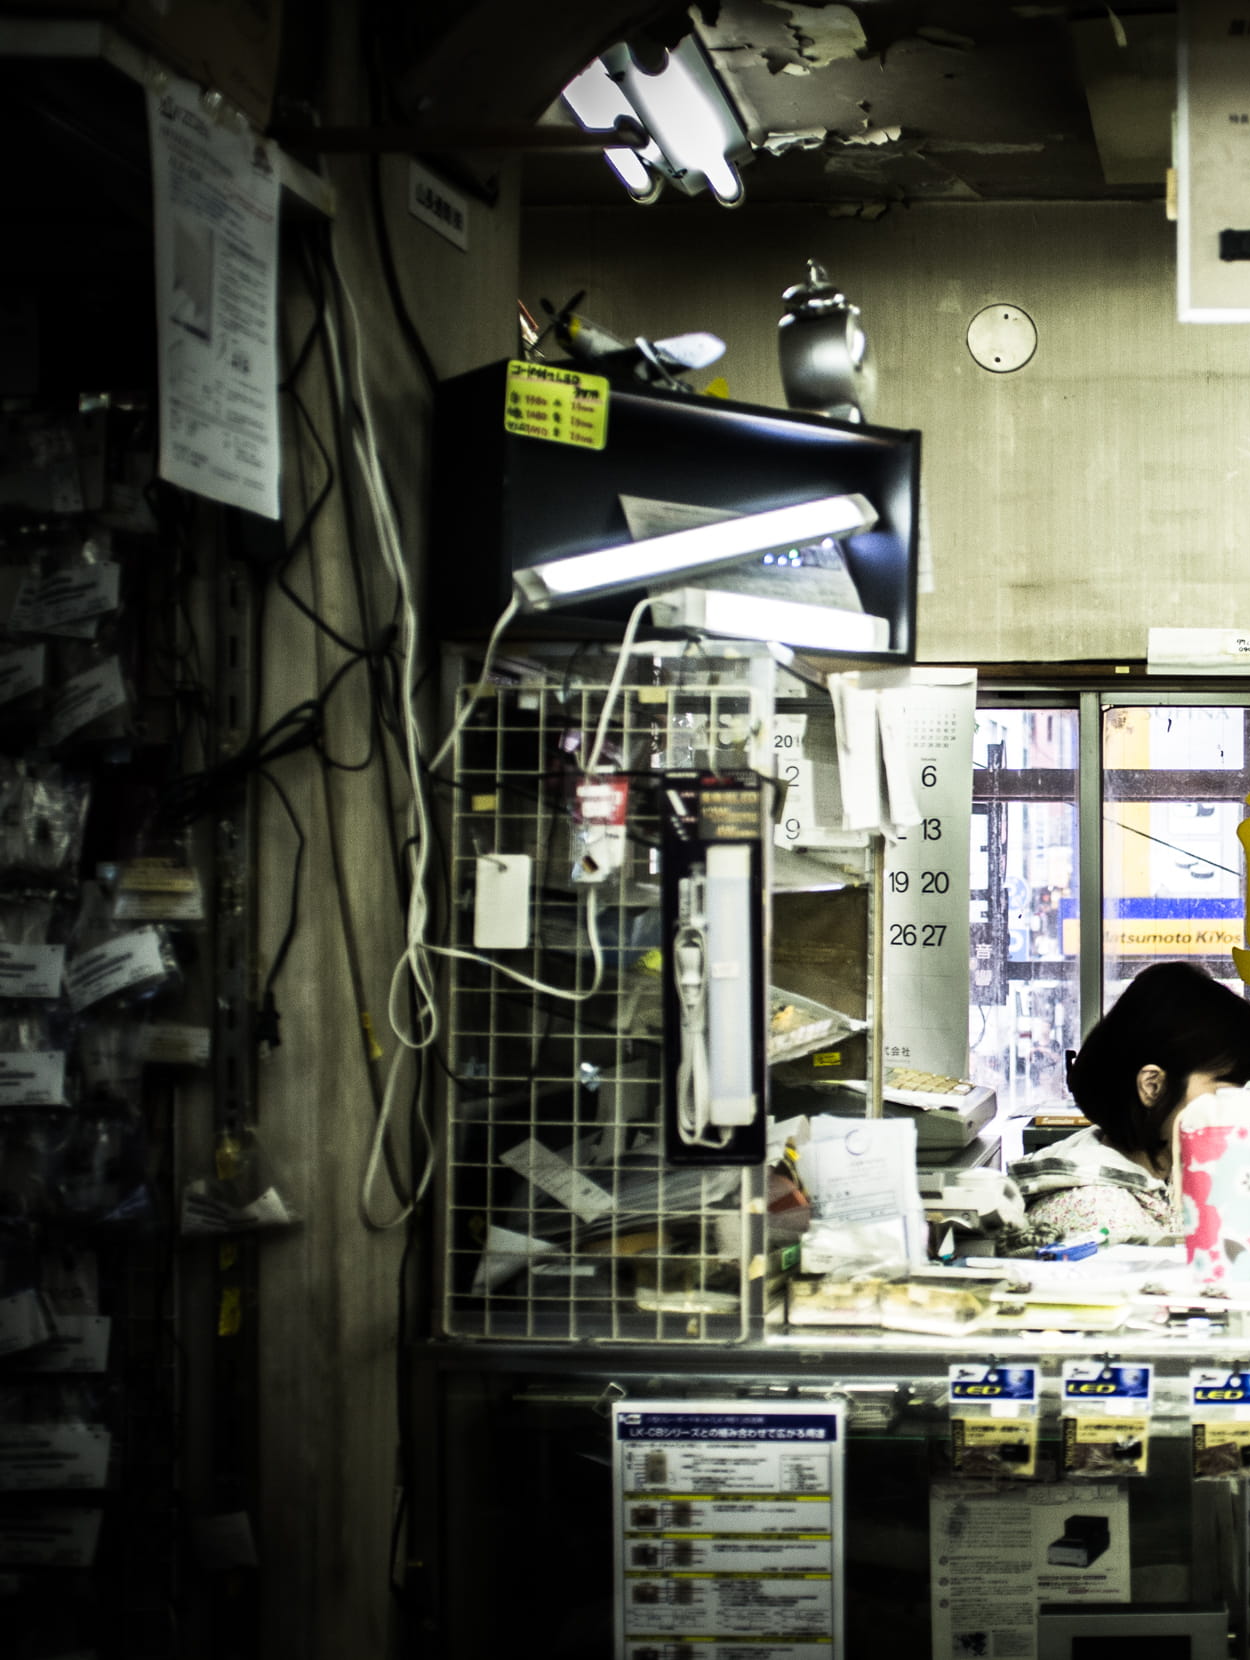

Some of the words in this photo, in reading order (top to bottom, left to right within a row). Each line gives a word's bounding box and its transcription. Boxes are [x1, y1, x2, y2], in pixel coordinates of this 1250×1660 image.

[921, 765, 937, 787] 6
[785, 818, 800, 840] 9
[920, 818, 942, 841] 13
[889, 871, 910, 893] 19
[921, 871, 950, 894] 20
[889, 924, 917, 946] 26
[921, 924, 947, 947] 27
[953, 1384, 1001, 1395] LED
[1067, 1383, 1116, 1394] LED
[1195, 1389, 1244, 1400] LED
